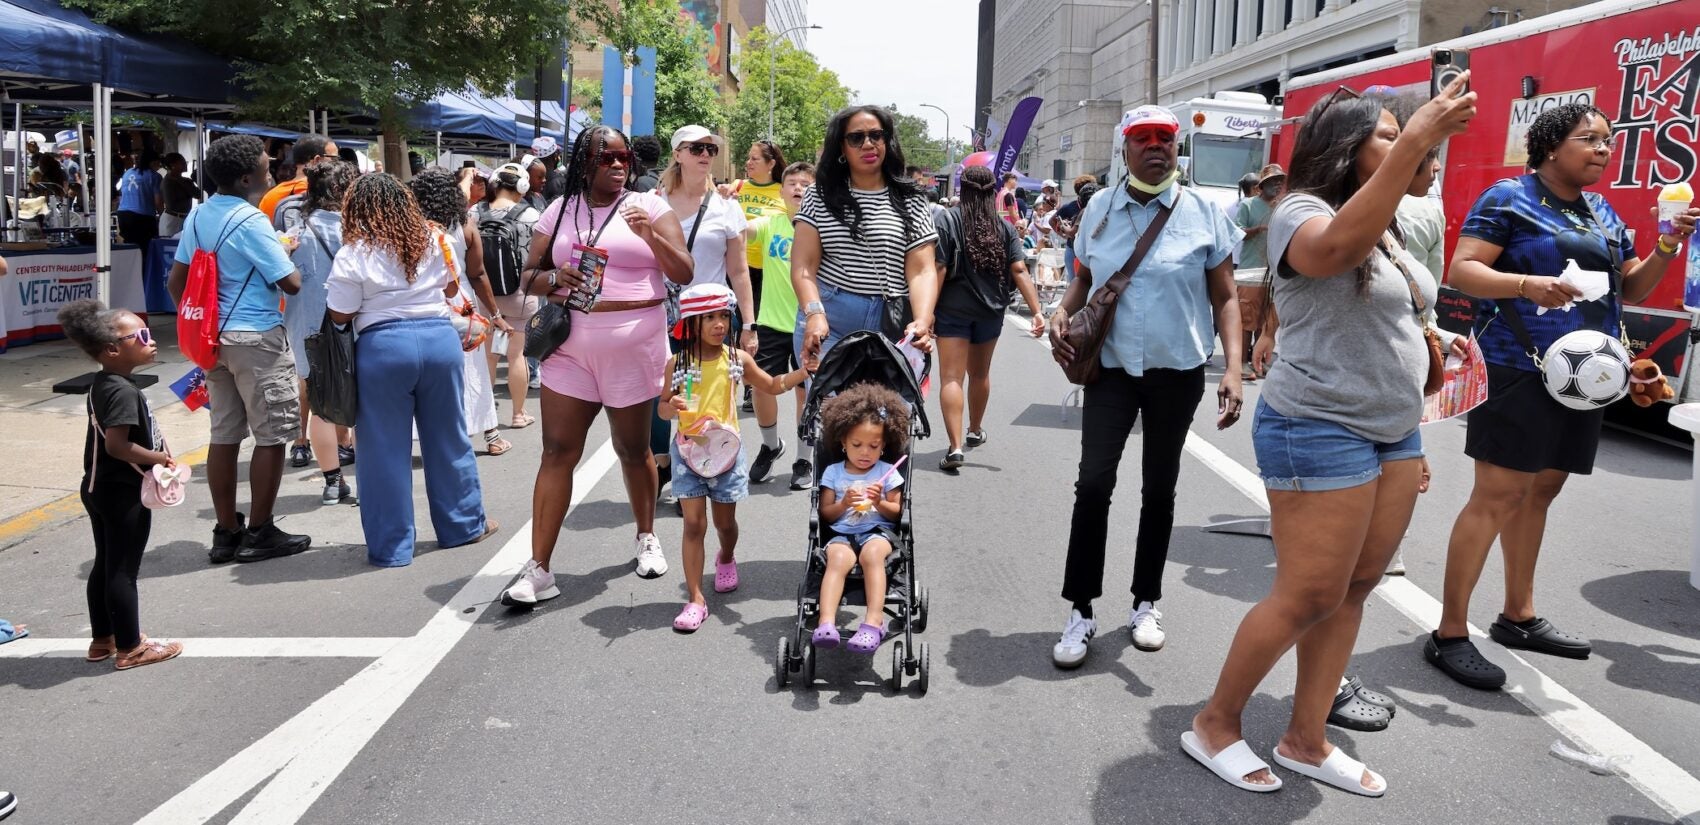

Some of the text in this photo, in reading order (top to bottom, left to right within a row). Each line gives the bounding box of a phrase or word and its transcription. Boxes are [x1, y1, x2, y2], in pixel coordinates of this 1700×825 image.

[16, 265, 40, 275] CENTER
[41, 264, 56, 273] CITY
[19, 279, 92, 306] VET CENTER
